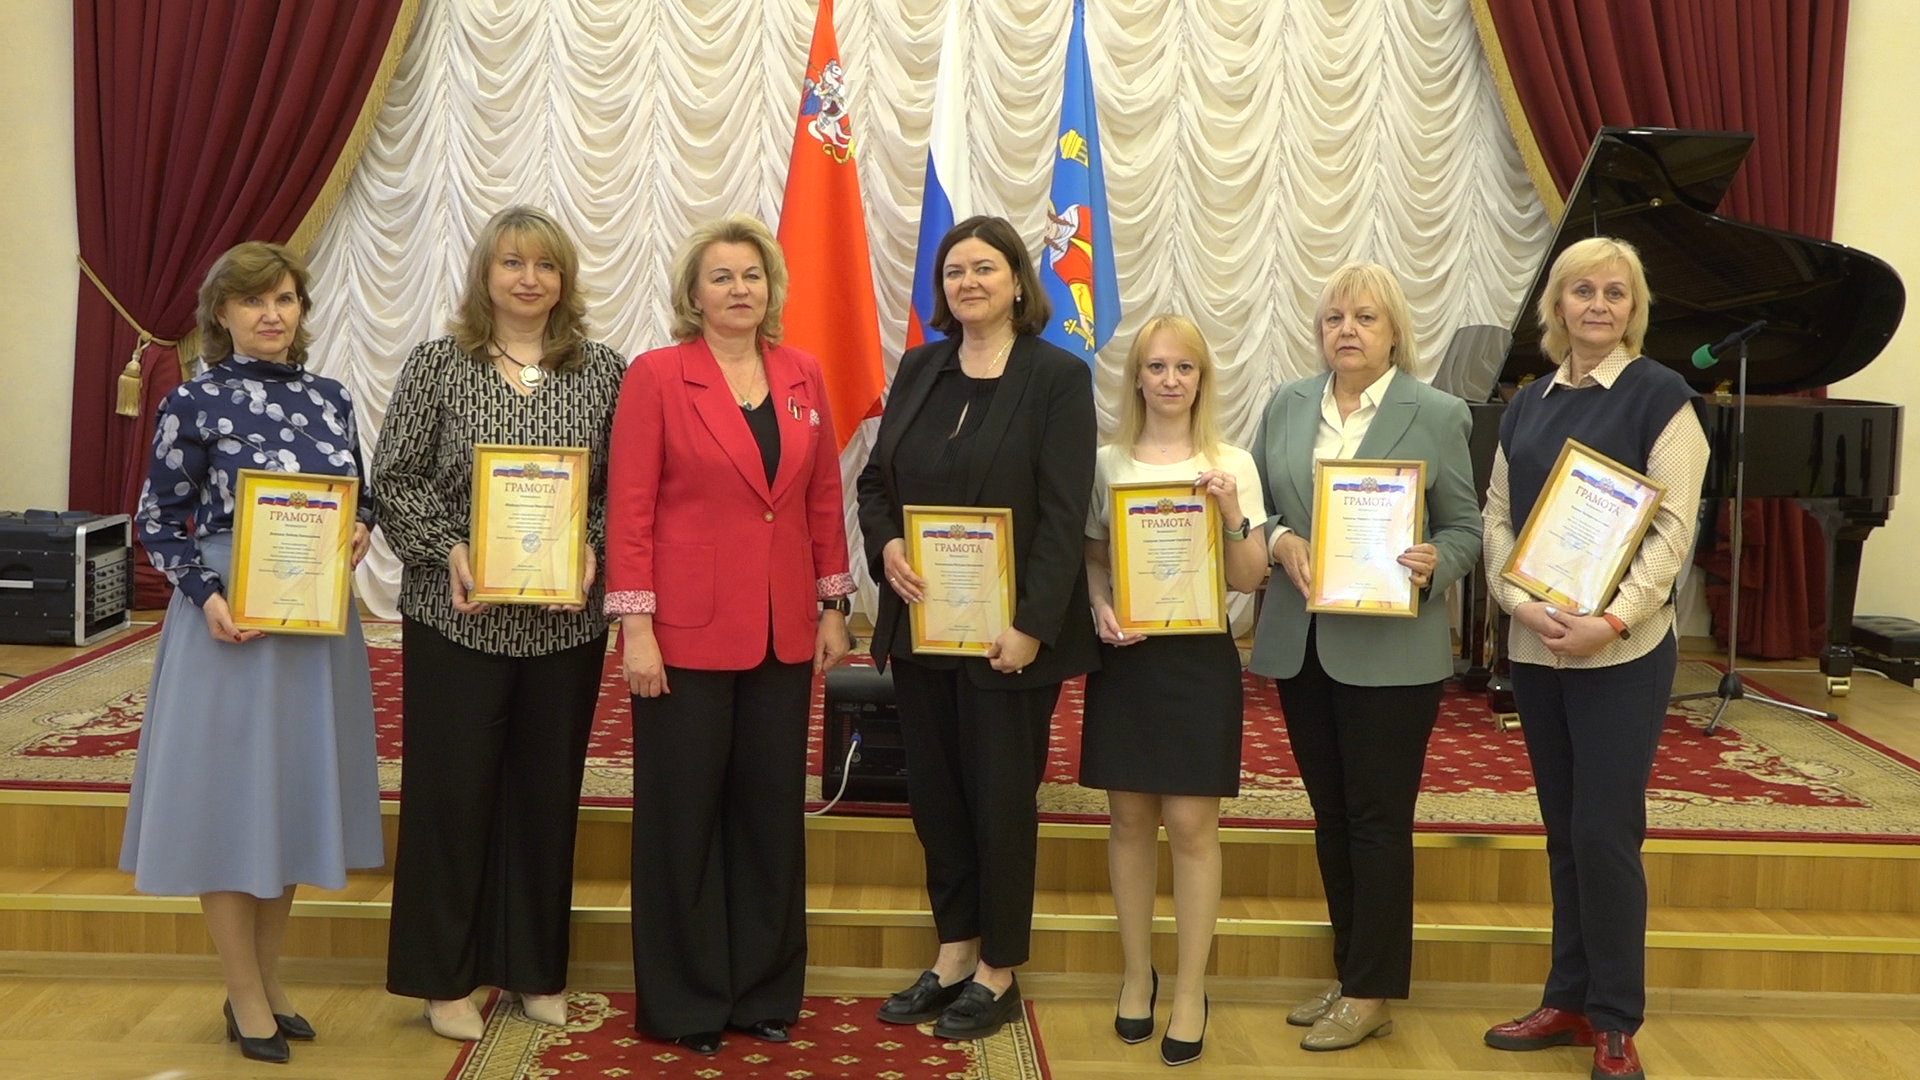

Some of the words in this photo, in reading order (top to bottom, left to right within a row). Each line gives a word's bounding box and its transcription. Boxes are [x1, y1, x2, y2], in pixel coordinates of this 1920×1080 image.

[504, 482, 556, 494] ГРАМОТА
[1343, 496, 1393, 507] ГРАМОТА
[1574, 485, 1621, 517] ГРАМОТА
[269, 510, 324, 524] ГРАМОТА
[1141, 517, 1192, 529] ГРАМОТА
[934, 542, 984, 554] ГРАМОТА
